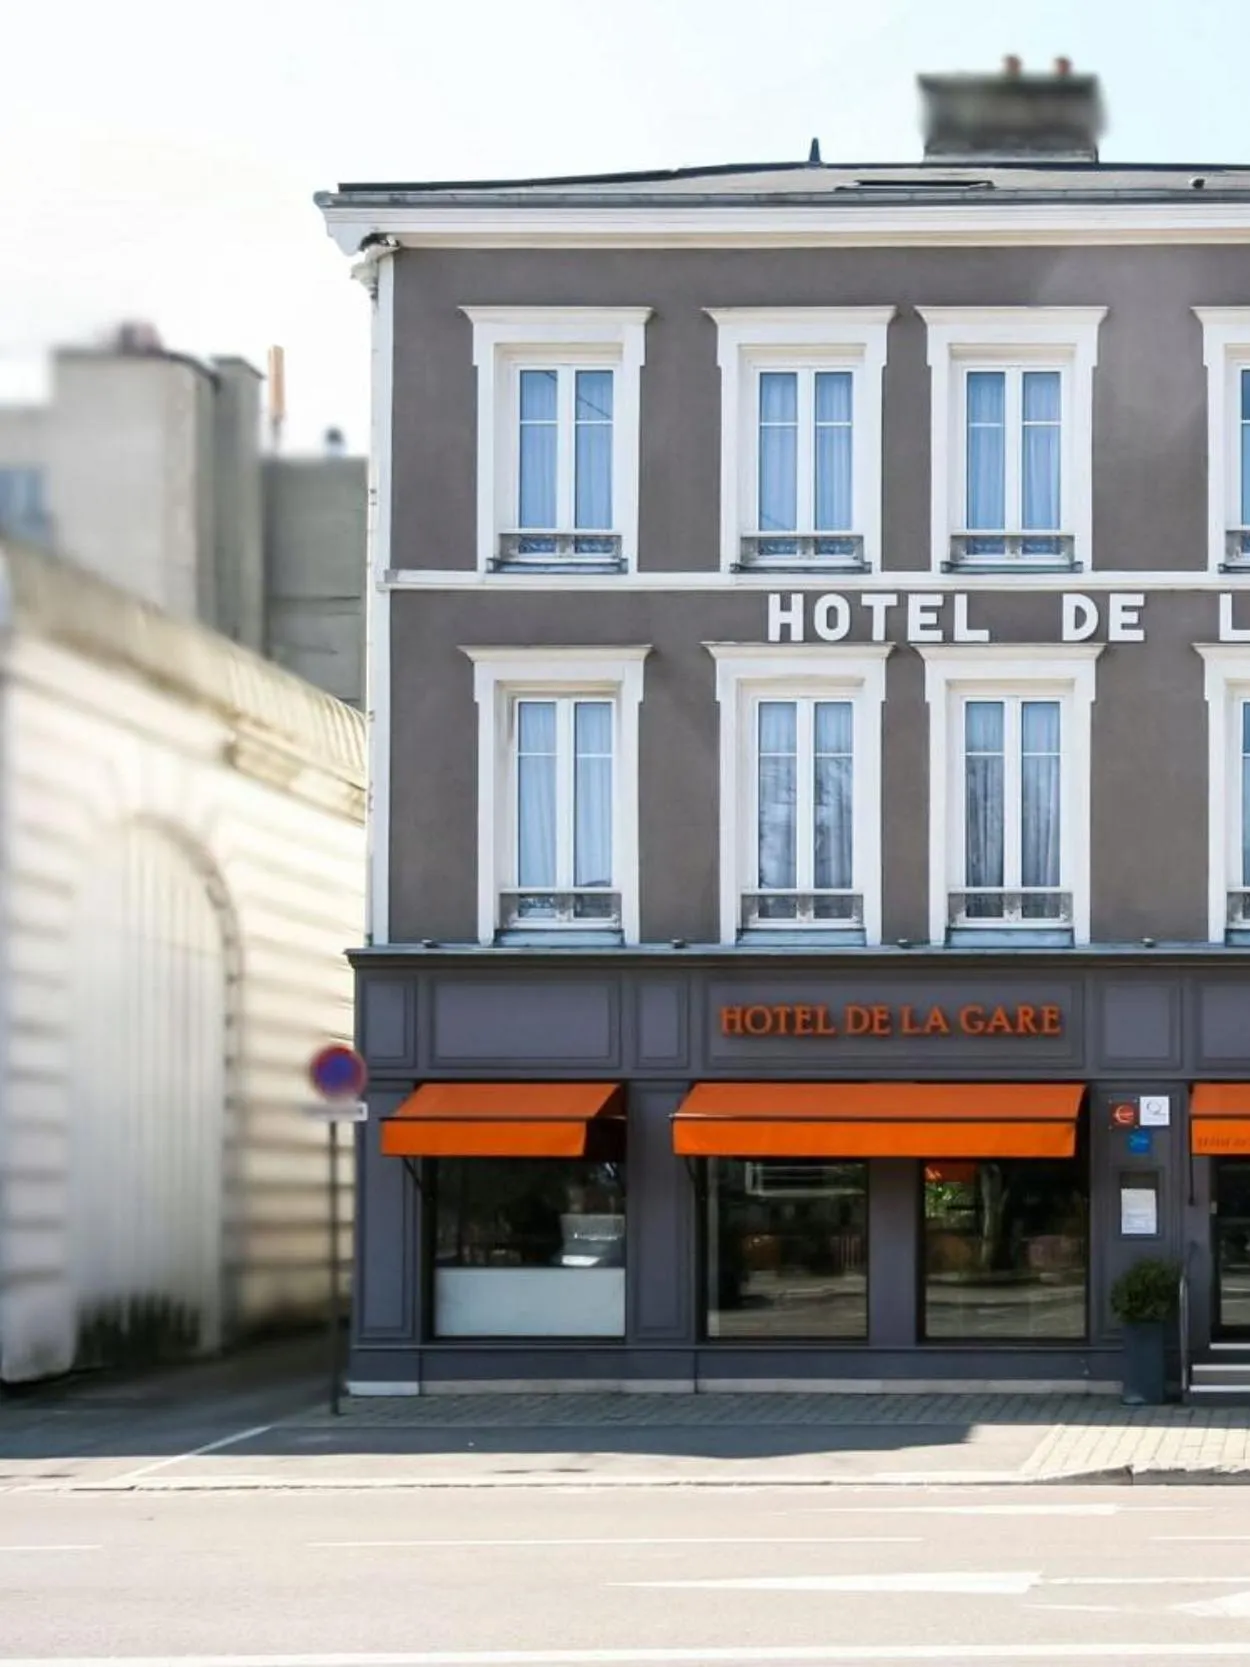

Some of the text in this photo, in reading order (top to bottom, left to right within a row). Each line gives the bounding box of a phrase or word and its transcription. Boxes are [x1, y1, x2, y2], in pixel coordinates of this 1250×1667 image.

[767, 593, 990, 642] HOTEL
[1061, 593, 1146, 642] DE
[720, 1005, 1062, 1036] HOTEL DE LA GARE
